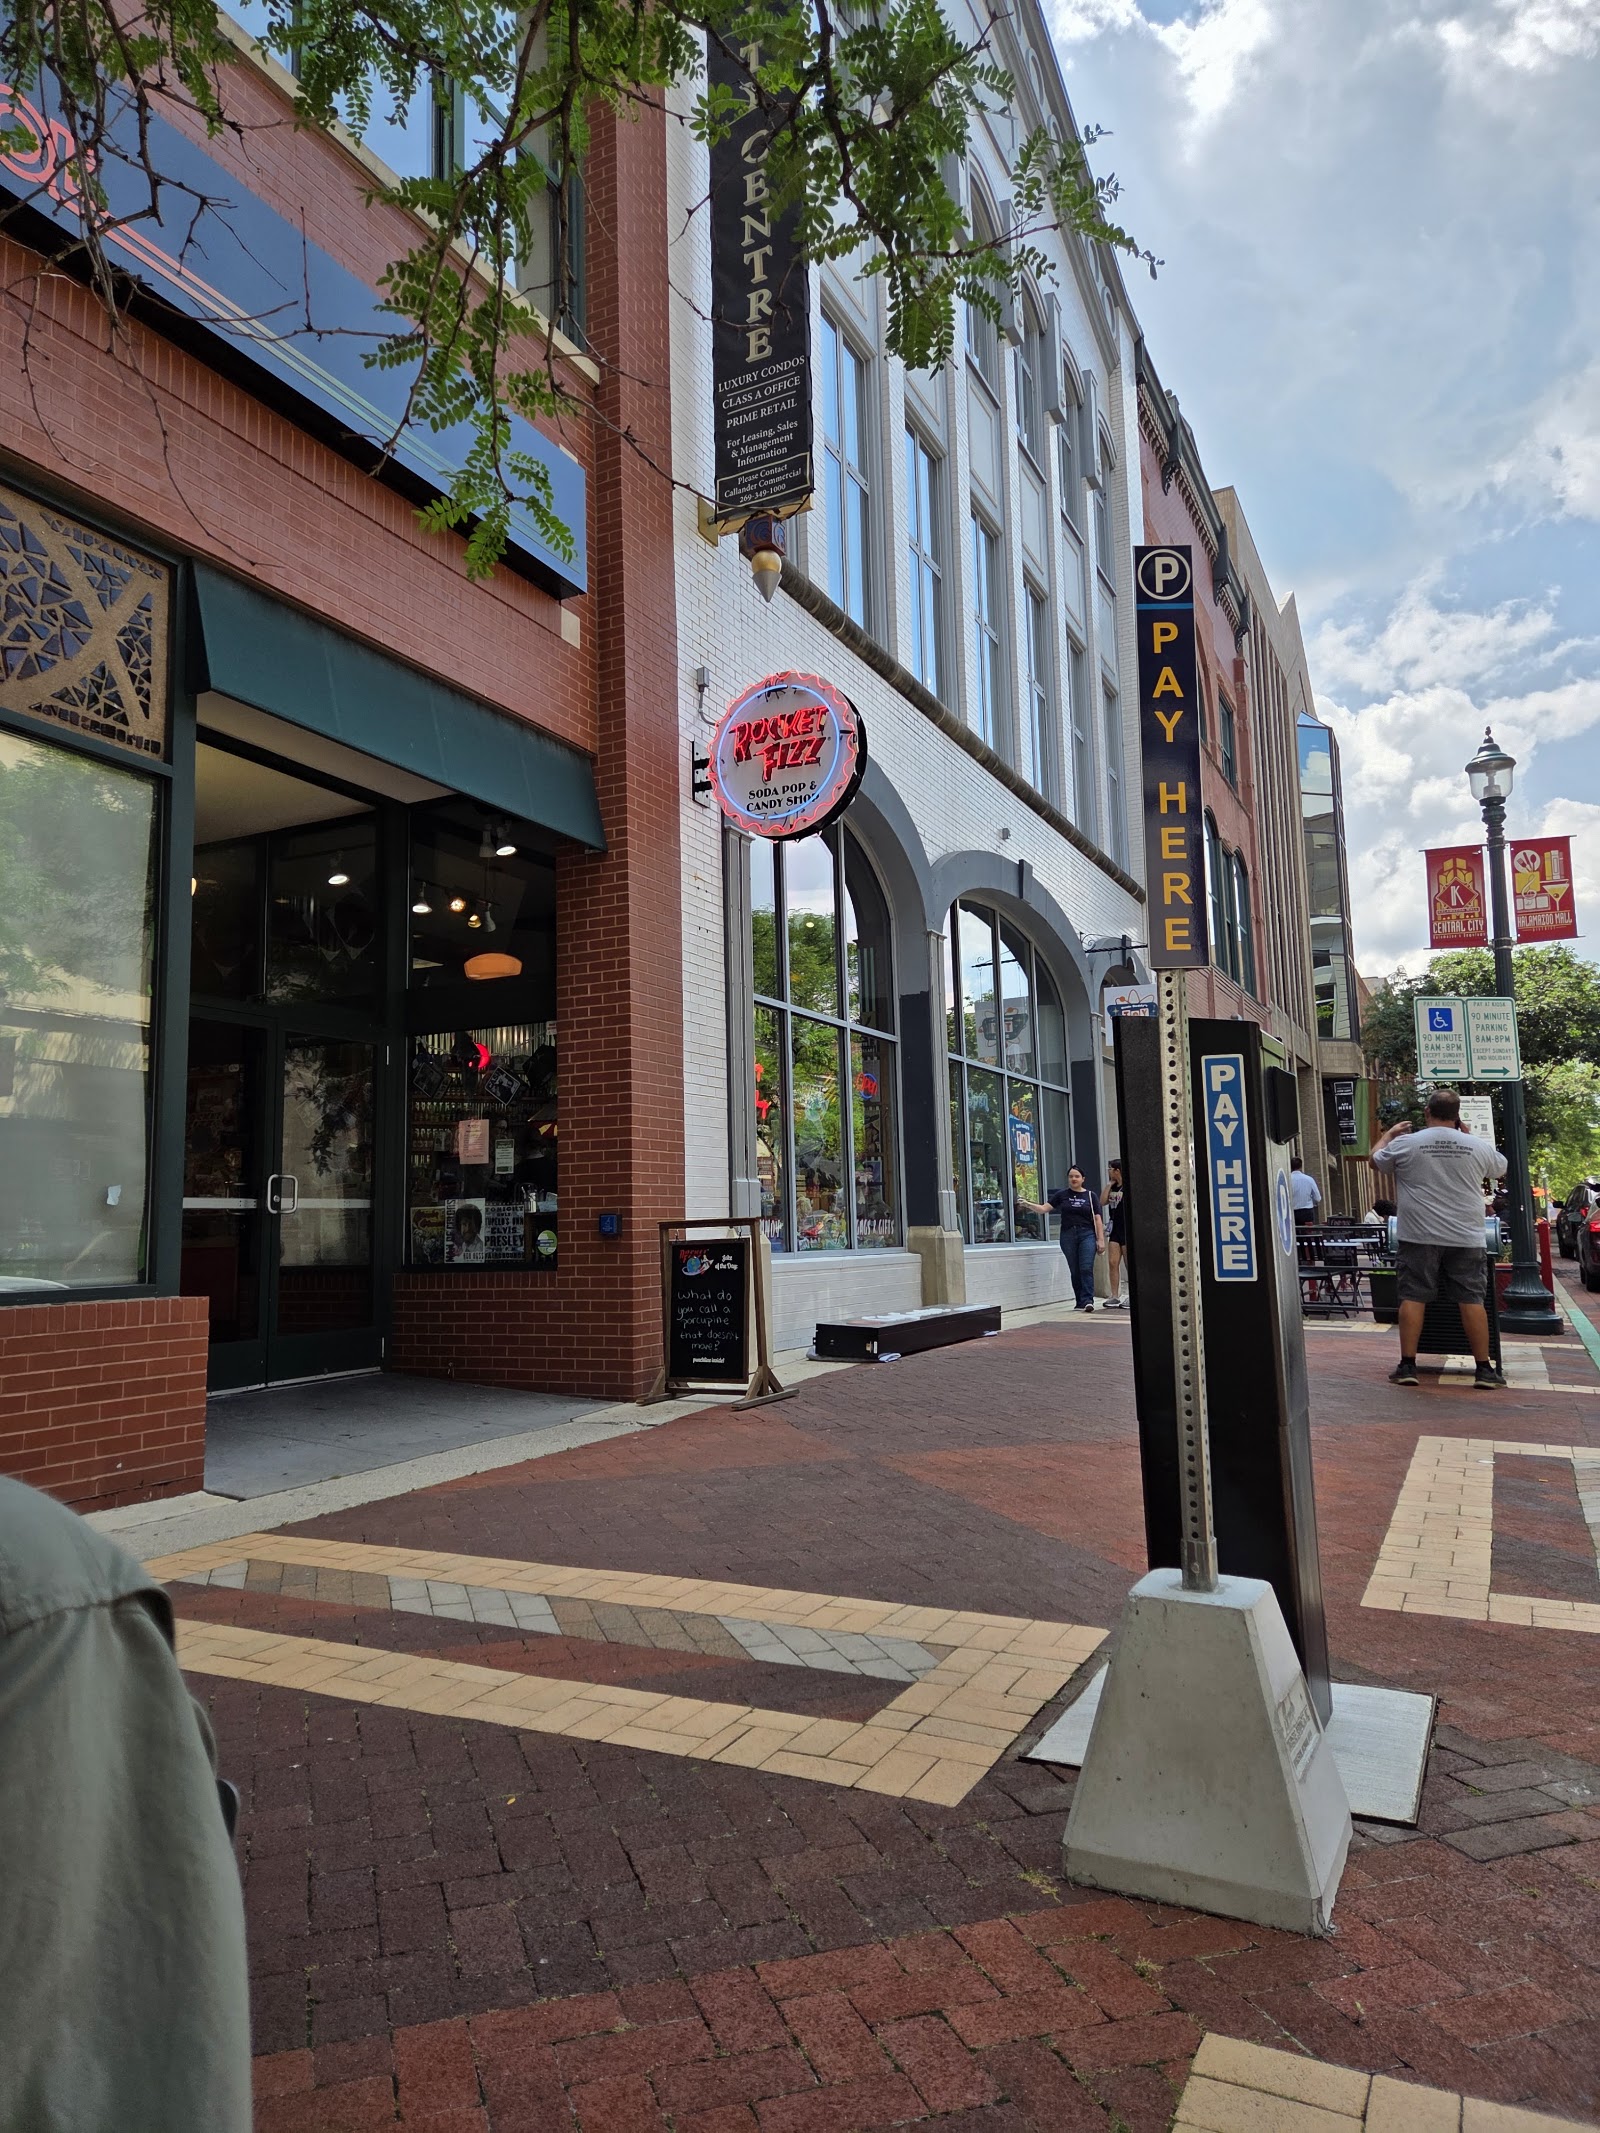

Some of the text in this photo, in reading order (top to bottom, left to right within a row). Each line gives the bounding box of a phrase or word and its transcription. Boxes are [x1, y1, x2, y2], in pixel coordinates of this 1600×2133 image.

[740, 129, 773, 364] CENTRE
[718, 355, 805, 393] LUXURY CONDOS
[722, 375, 801, 410] CLASS A OFFICE
[726, 398, 797, 429] PRIME RETAIL
[727, 420, 798, 449] For Leasing, Sales
[731, 432, 794, 458] & Management
[737, 446, 788, 468] Information
[724, 468, 802, 498] Callander Commercial
[738, 463, 788, 485] Please Contact
[740, 483, 786, 503] 269-349-1000
[1155, 556, 1180, 593] P
[729, 705, 829, 763] ROCKET
[753, 736, 826, 783] FIZZ
[748, 781, 818, 800] SODA POP &
[1151, 621, 1193, 951] PAY HERE
[746, 793, 820, 813] CANDY SHOP
[1450, 885, 1465, 907] K
[1432, 918, 1484, 934] CENTRAL CITY
[1517, 911, 1573, 928] KALAMAZOO MALL
[1471, 1012, 1511, 1020] 90 MINUTE
[1422, 1034, 1463, 1042] 90 MINUTE
[1475, 1024, 1508, 1032] PARKING
[1424, 1043, 1462, 1051] 8AM-8PM
[1475, 1035, 1511, 1043] 8AM-8PM
[1210, 1064, 1249, 1271] PAY HERE
[490, 1226, 517, 1234] ELVIS
[856, 1218, 872, 1236] GAGS
[878, 1219, 894, 1235] GIFTS
[485, 1235, 524, 1247] PRESLEY
[717, 1289, 732, 1300] do
[677, 1304, 693, 1320] you
[699, 1303, 717, 1314] call
[680, 1315, 729, 1329] porcupine
[680, 1330, 703, 1339] that
